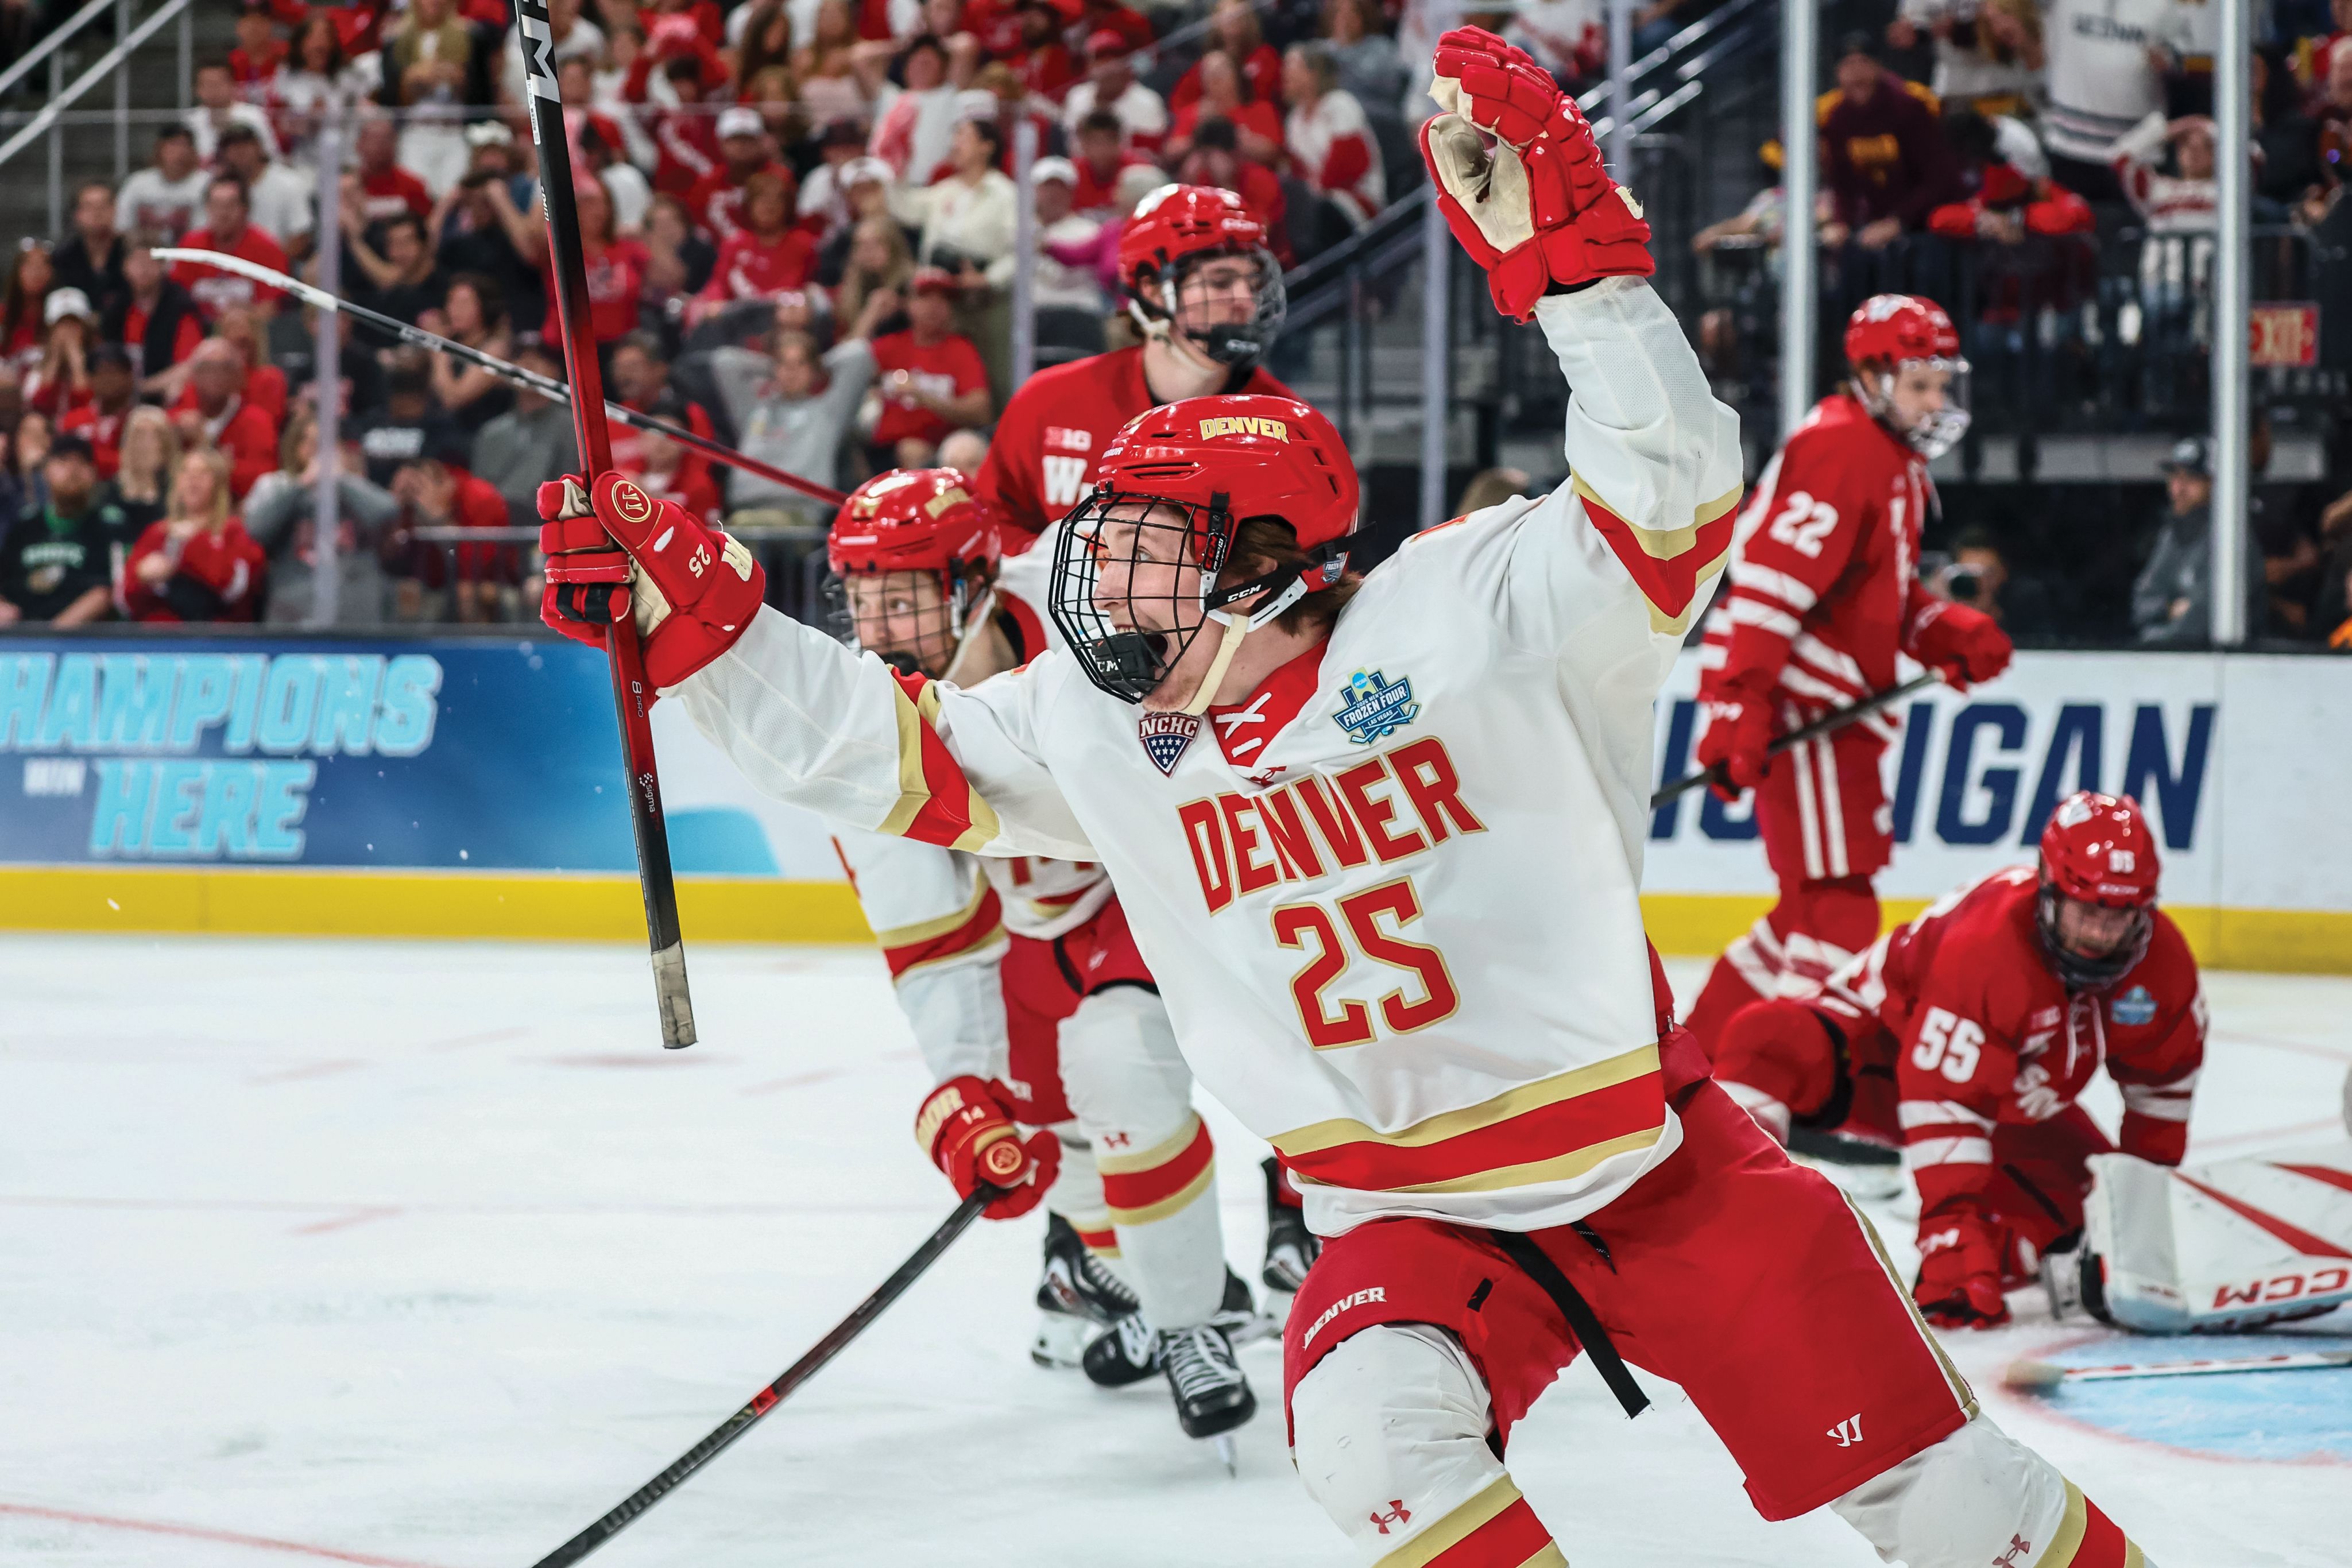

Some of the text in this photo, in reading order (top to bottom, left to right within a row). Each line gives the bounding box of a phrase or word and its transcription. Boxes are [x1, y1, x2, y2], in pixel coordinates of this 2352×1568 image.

[1199, 416, 1290, 444] DENVER
[1769, 490, 1839, 559] 22
[689, 543, 711, 579] 25
[1227, 584, 1262, 602] CCM
[1096, 658, 1121, 673] CM
[632, 680, 644, 718] 8 PRO
[1343, 685, 1406, 727] FROZEN FOUR
[1368, 691, 1383, 702] MEN'S
[1140, 717, 1198, 737] NCHC
[1367, 710, 1393, 726] LAS VEGAS
[1648, 698, 2219, 850] IIGAN
[88, 759, 316, 860] HERE
[645, 784, 656, 813] sigma
[1175, 735, 1490, 917] DENVER
[1270, 875, 1460, 1050] 25
[1911, 1005, 1986, 1085] 55
[2211, 1268, 2349, 1308] CCM
[1302, 1286, 1387, 1352] DENVER
